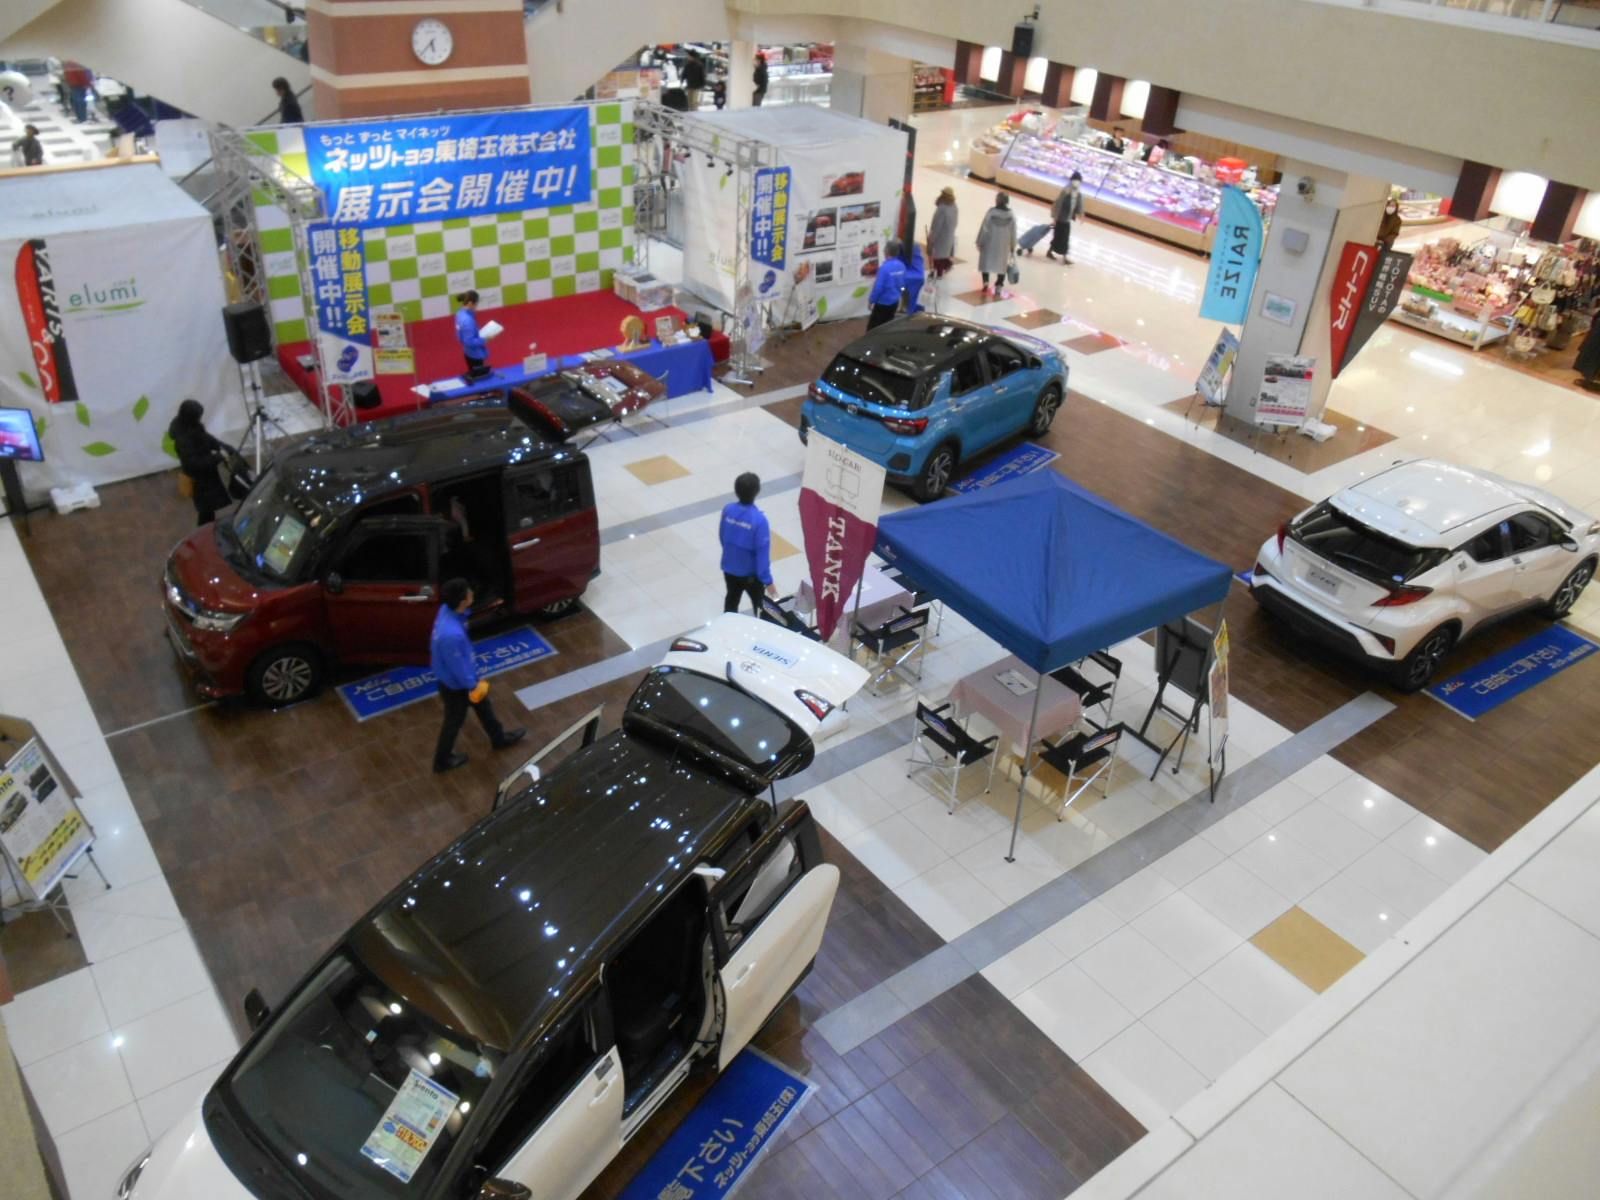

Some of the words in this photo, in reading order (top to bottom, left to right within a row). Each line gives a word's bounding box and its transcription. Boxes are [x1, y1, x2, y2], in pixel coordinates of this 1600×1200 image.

[35, 248, 64, 338] YARIS
[69, 282, 138, 307] elumi
[338, 227, 367, 335] 移動展示会
[821, 516, 846, 603] TANK
